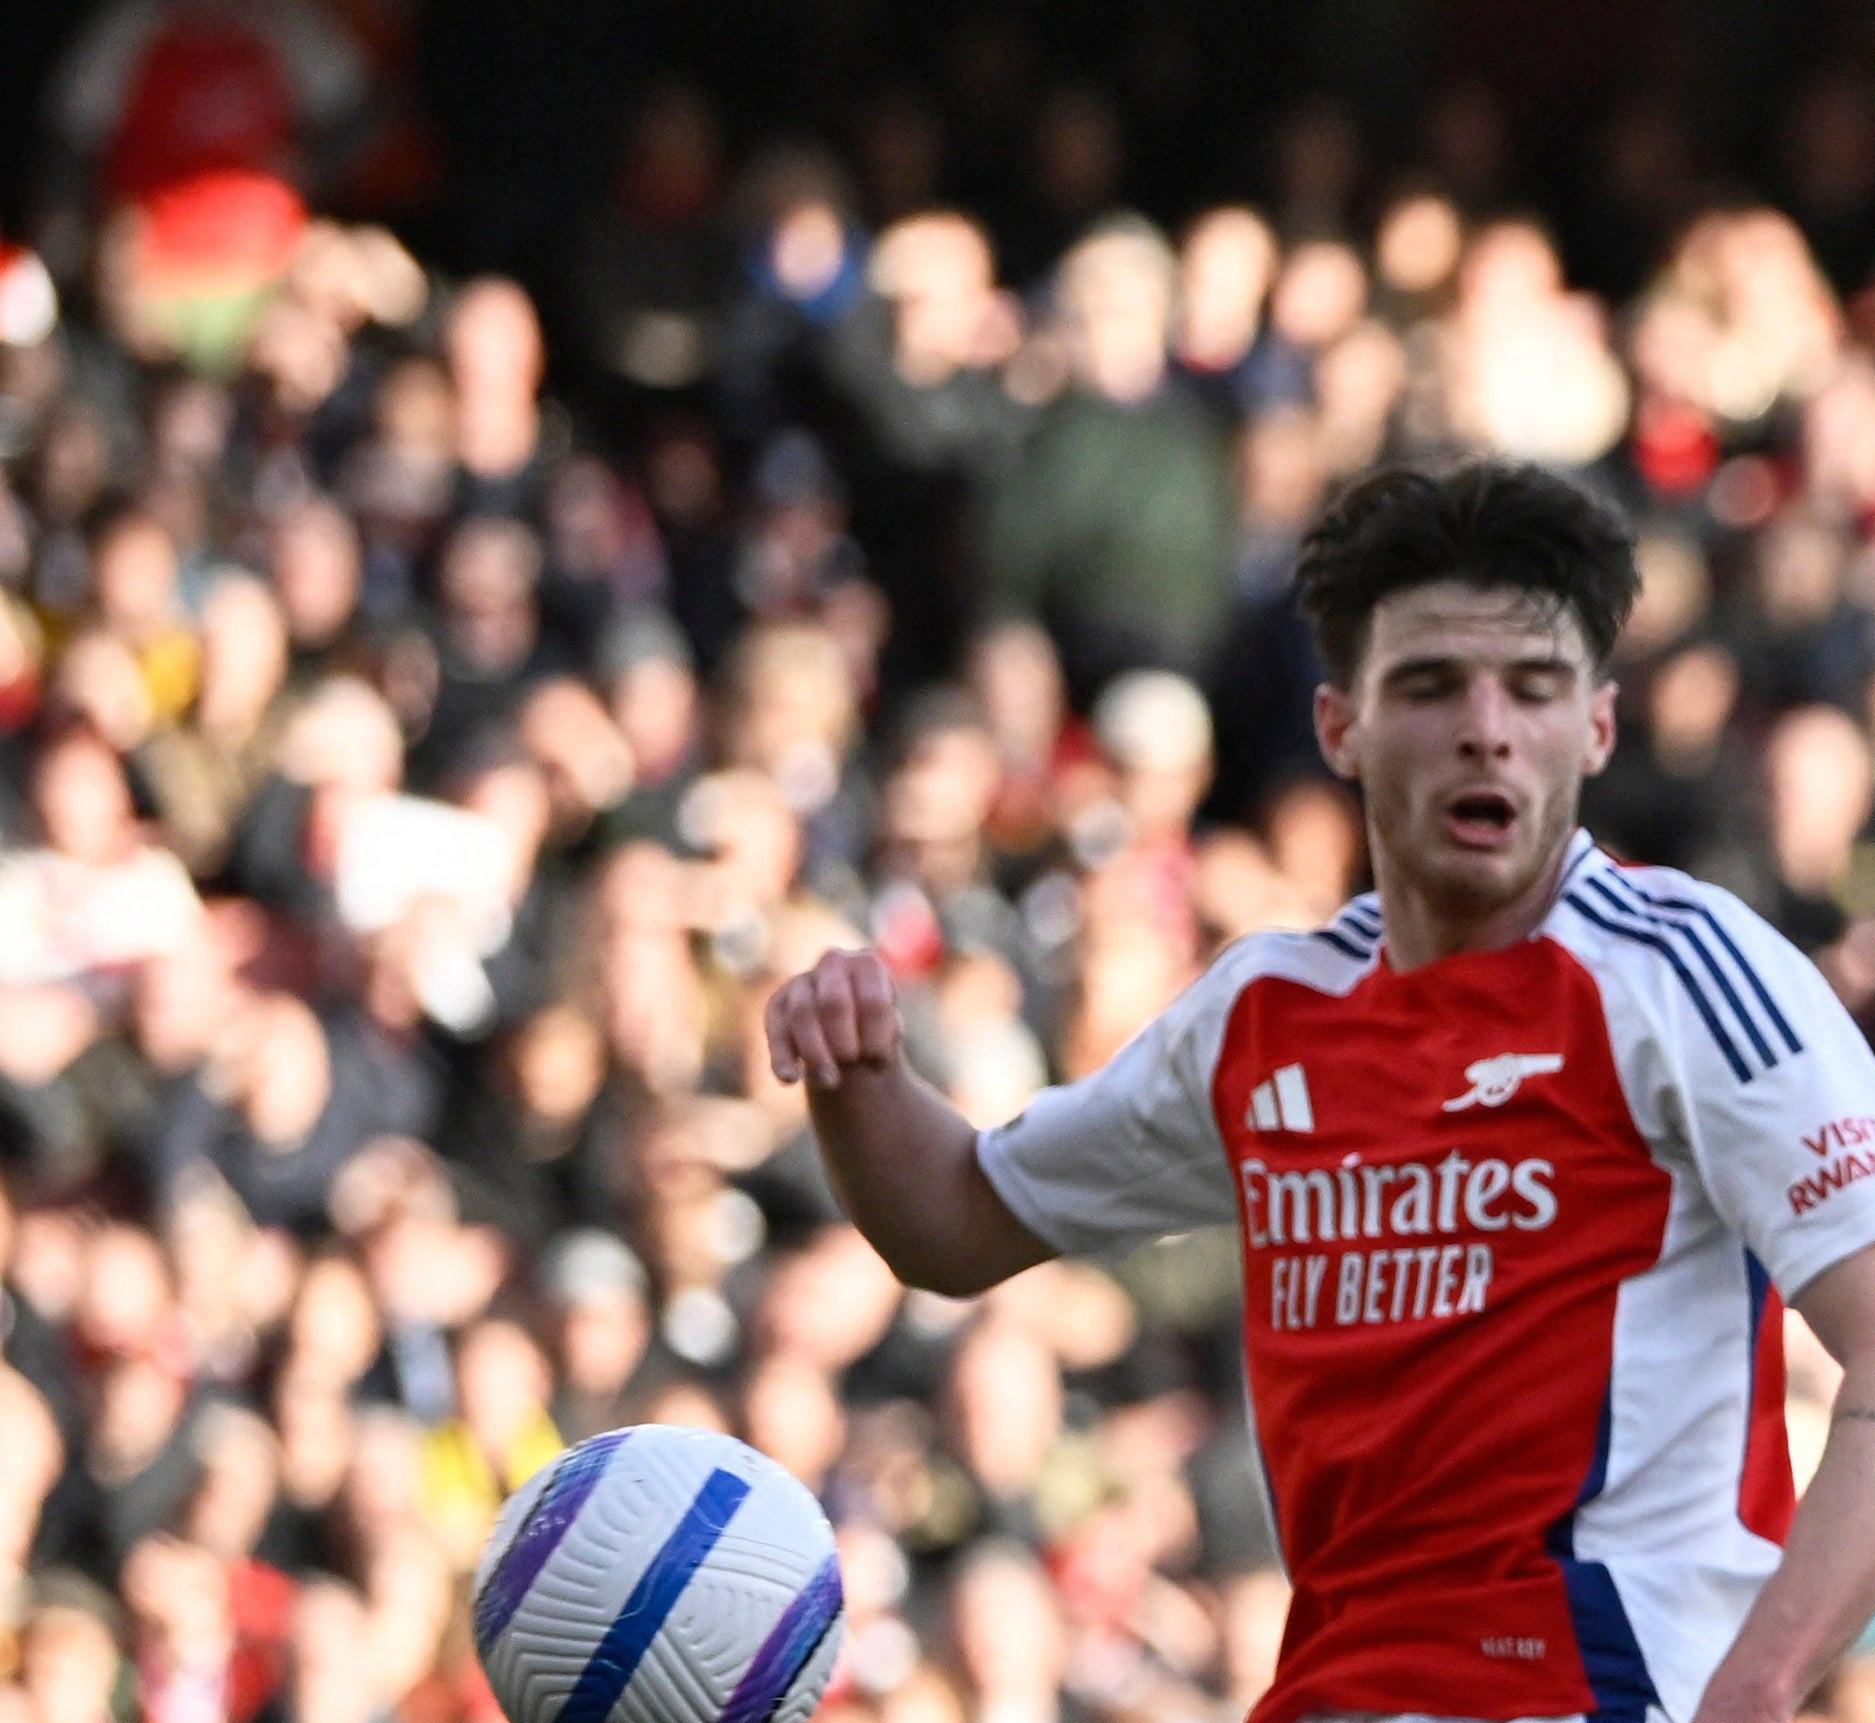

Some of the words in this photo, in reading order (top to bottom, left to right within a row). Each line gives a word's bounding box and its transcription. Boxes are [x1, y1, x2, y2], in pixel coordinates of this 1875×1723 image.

[1241, 1149, 1558, 1249] Emirates
[1271, 1254, 1329, 1332] FLY
[1335, 1243, 1494, 1326] BETTER
